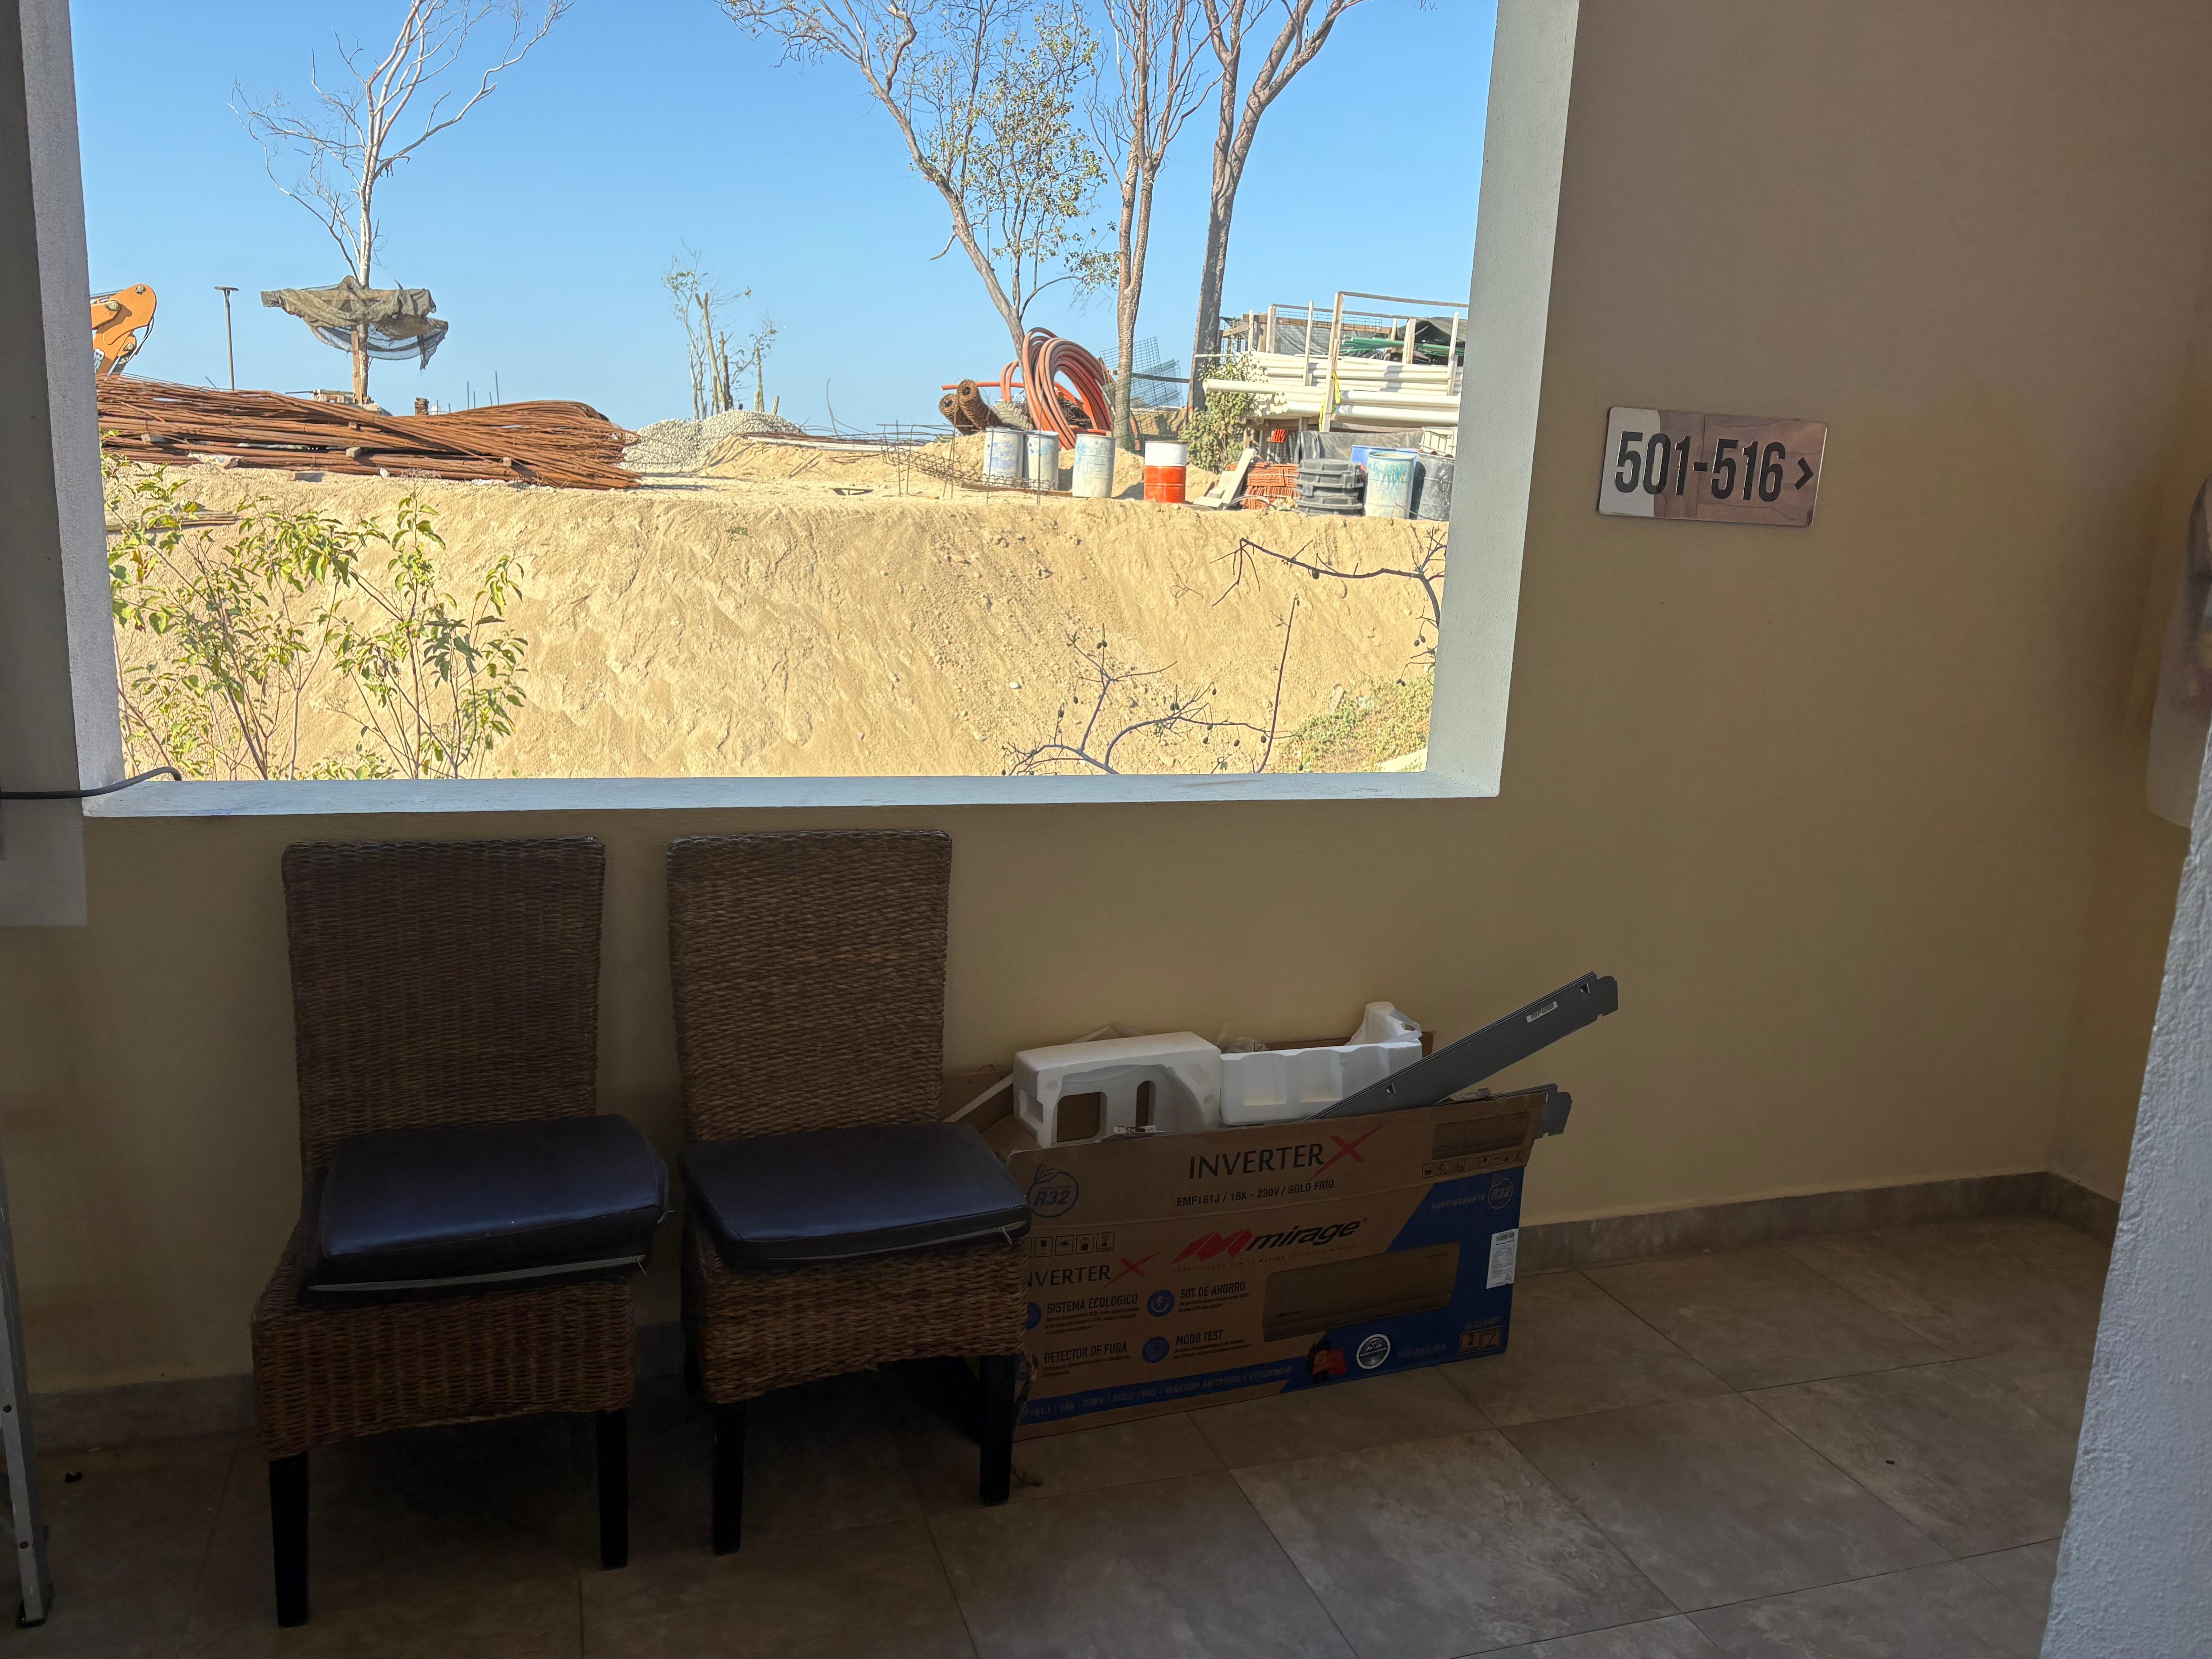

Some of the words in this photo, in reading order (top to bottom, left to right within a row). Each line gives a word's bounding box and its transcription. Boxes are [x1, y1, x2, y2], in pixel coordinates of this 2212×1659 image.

[1614, 431, 1786, 502] 501-516
[1189, 1144, 1324, 1179] INVERTER
[1034, 1190, 1071, 1206] R32
[1177, 1194, 1220, 1206] EMF181J
[1230, 1191, 1247, 1201] 18K
[1288, 1182, 1311, 1194] SOLO
[1314, 1178, 1334, 1190] FRÍO
[1491, 1186, 1511, 1200] R32
[1245, 1221, 1361, 1251] mirage
[1180, 1288, 1196, 1299] 50%
[1198, 1286, 1210, 1297] DE
[1211, 1281, 1245, 1295] AHORRO
[1047, 1299, 1086, 1314] SISTEMA
[1088, 1294, 1138, 1309] ECOLÓGICO
[1176, 1333, 1201, 1346] MODO
[1203, 1329, 1224, 1342] TEST
[1045, 1347, 1088, 1363] DETECTOR
[1091, 1345, 1102, 1356] DE
[1104, 1342, 1127, 1355] FUGA
